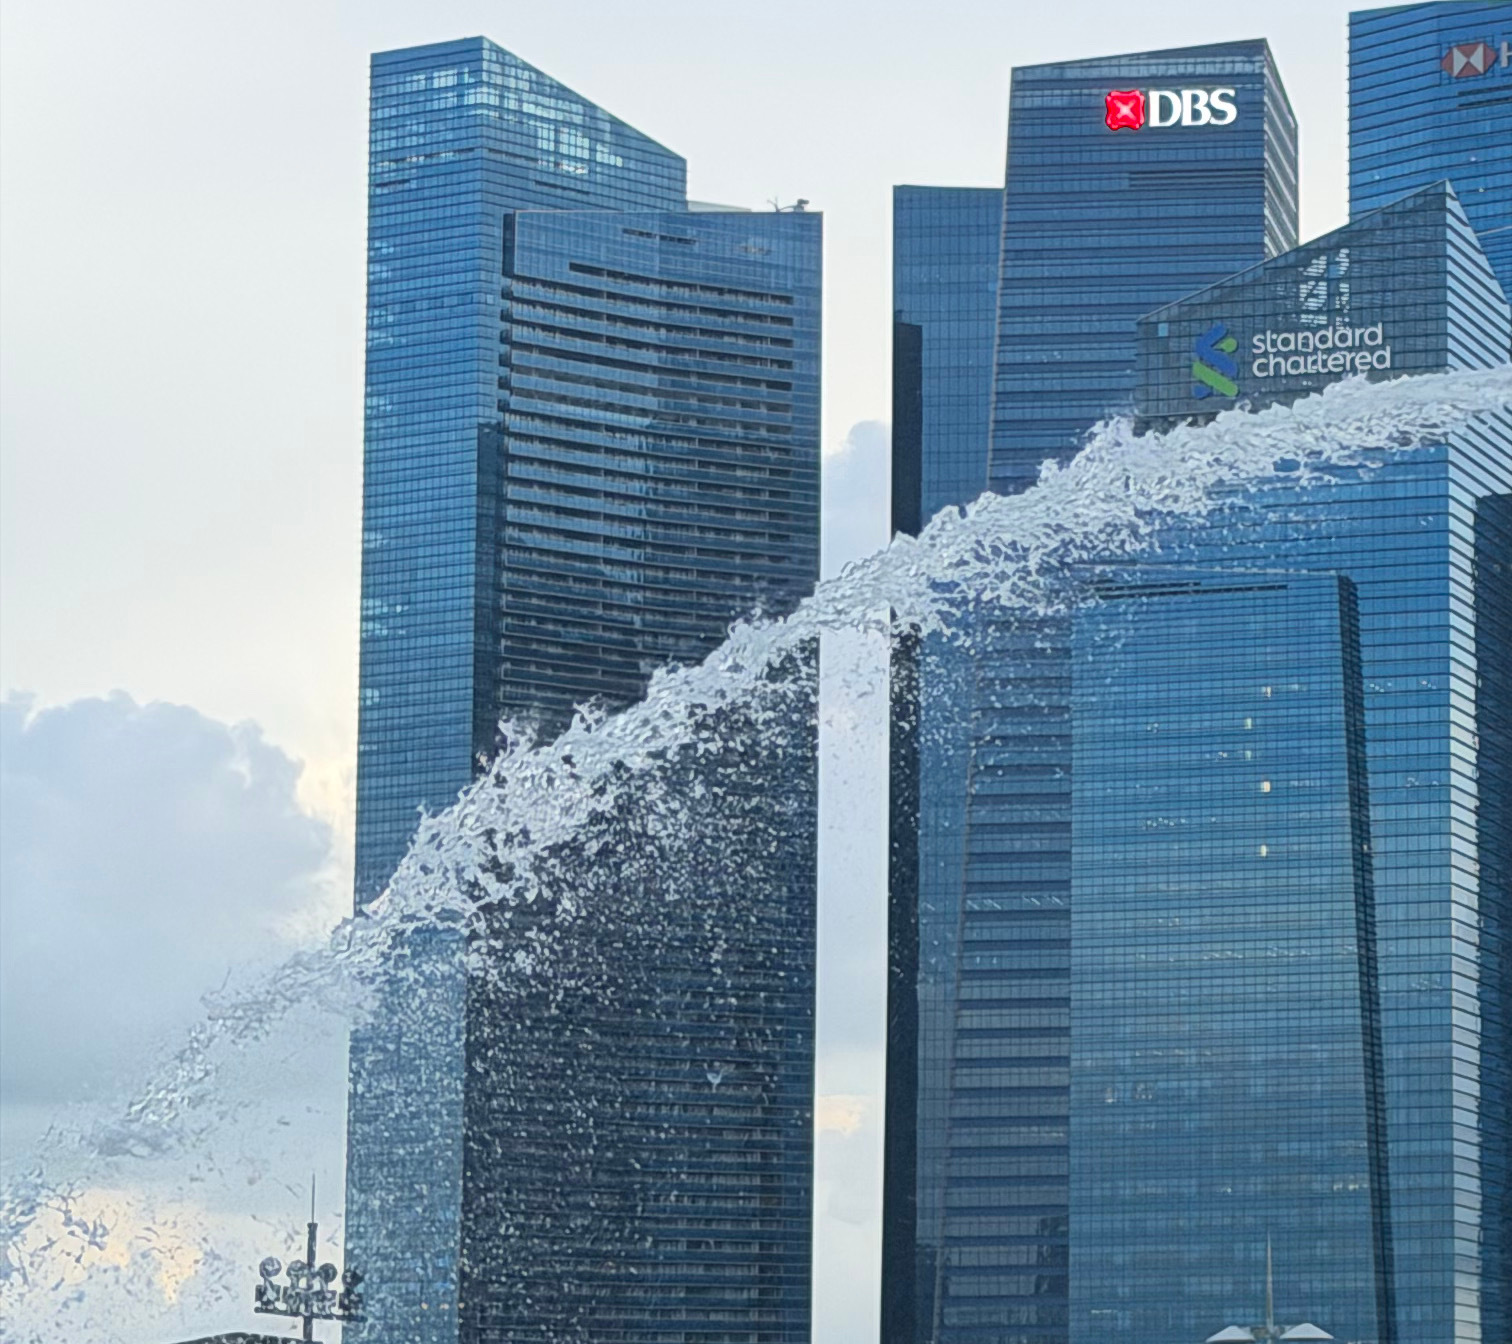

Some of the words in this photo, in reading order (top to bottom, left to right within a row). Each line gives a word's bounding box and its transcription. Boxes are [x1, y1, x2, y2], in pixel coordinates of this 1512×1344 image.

[1148, 88, 1237, 127] DBS
[1252, 322, 1383, 354] standard
[1252, 345, 1391, 378] chartered
